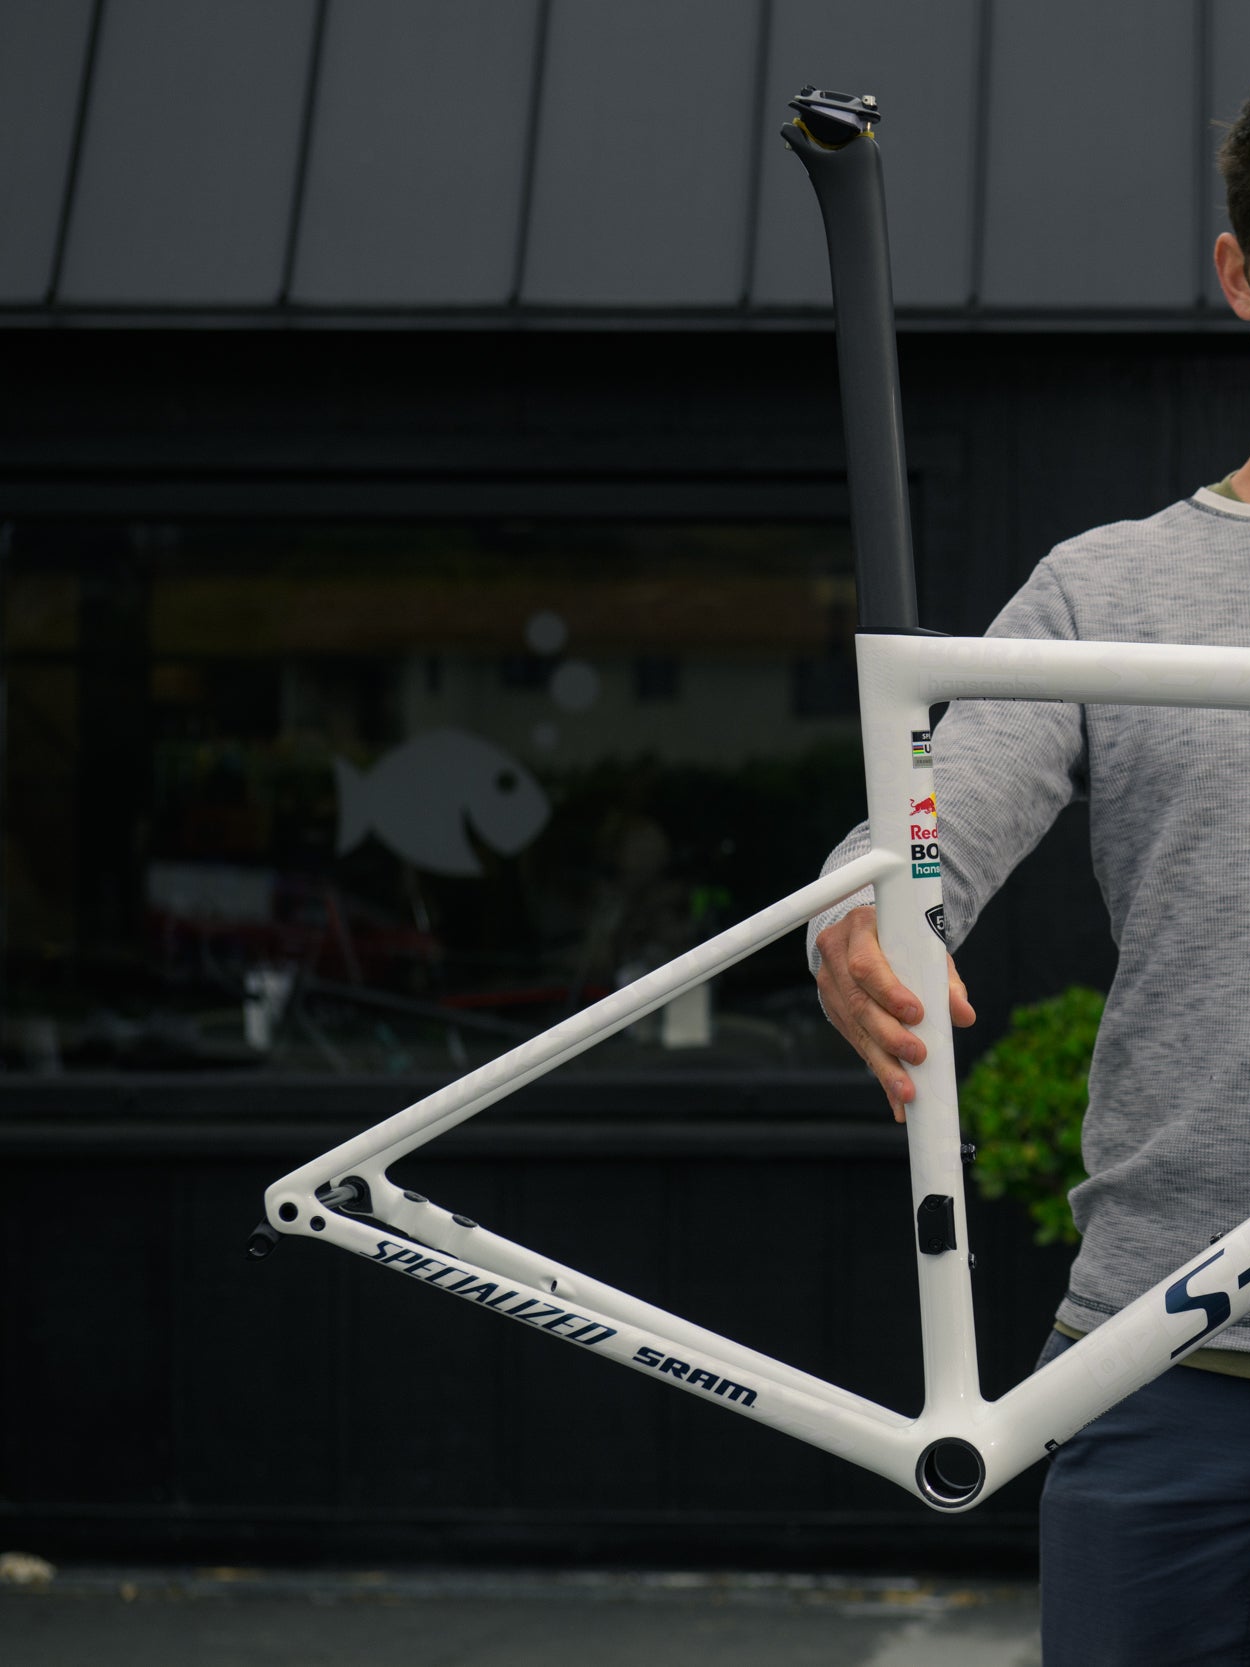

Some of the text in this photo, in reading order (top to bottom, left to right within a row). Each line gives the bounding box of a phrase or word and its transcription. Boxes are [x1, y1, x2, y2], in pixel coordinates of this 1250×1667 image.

[911, 823, 939, 840] Red
[911, 843, 939, 861] BO
[360, 1239, 618, 1346] SPECIALIZED
[632, 1346, 758, 1408] SRAM
